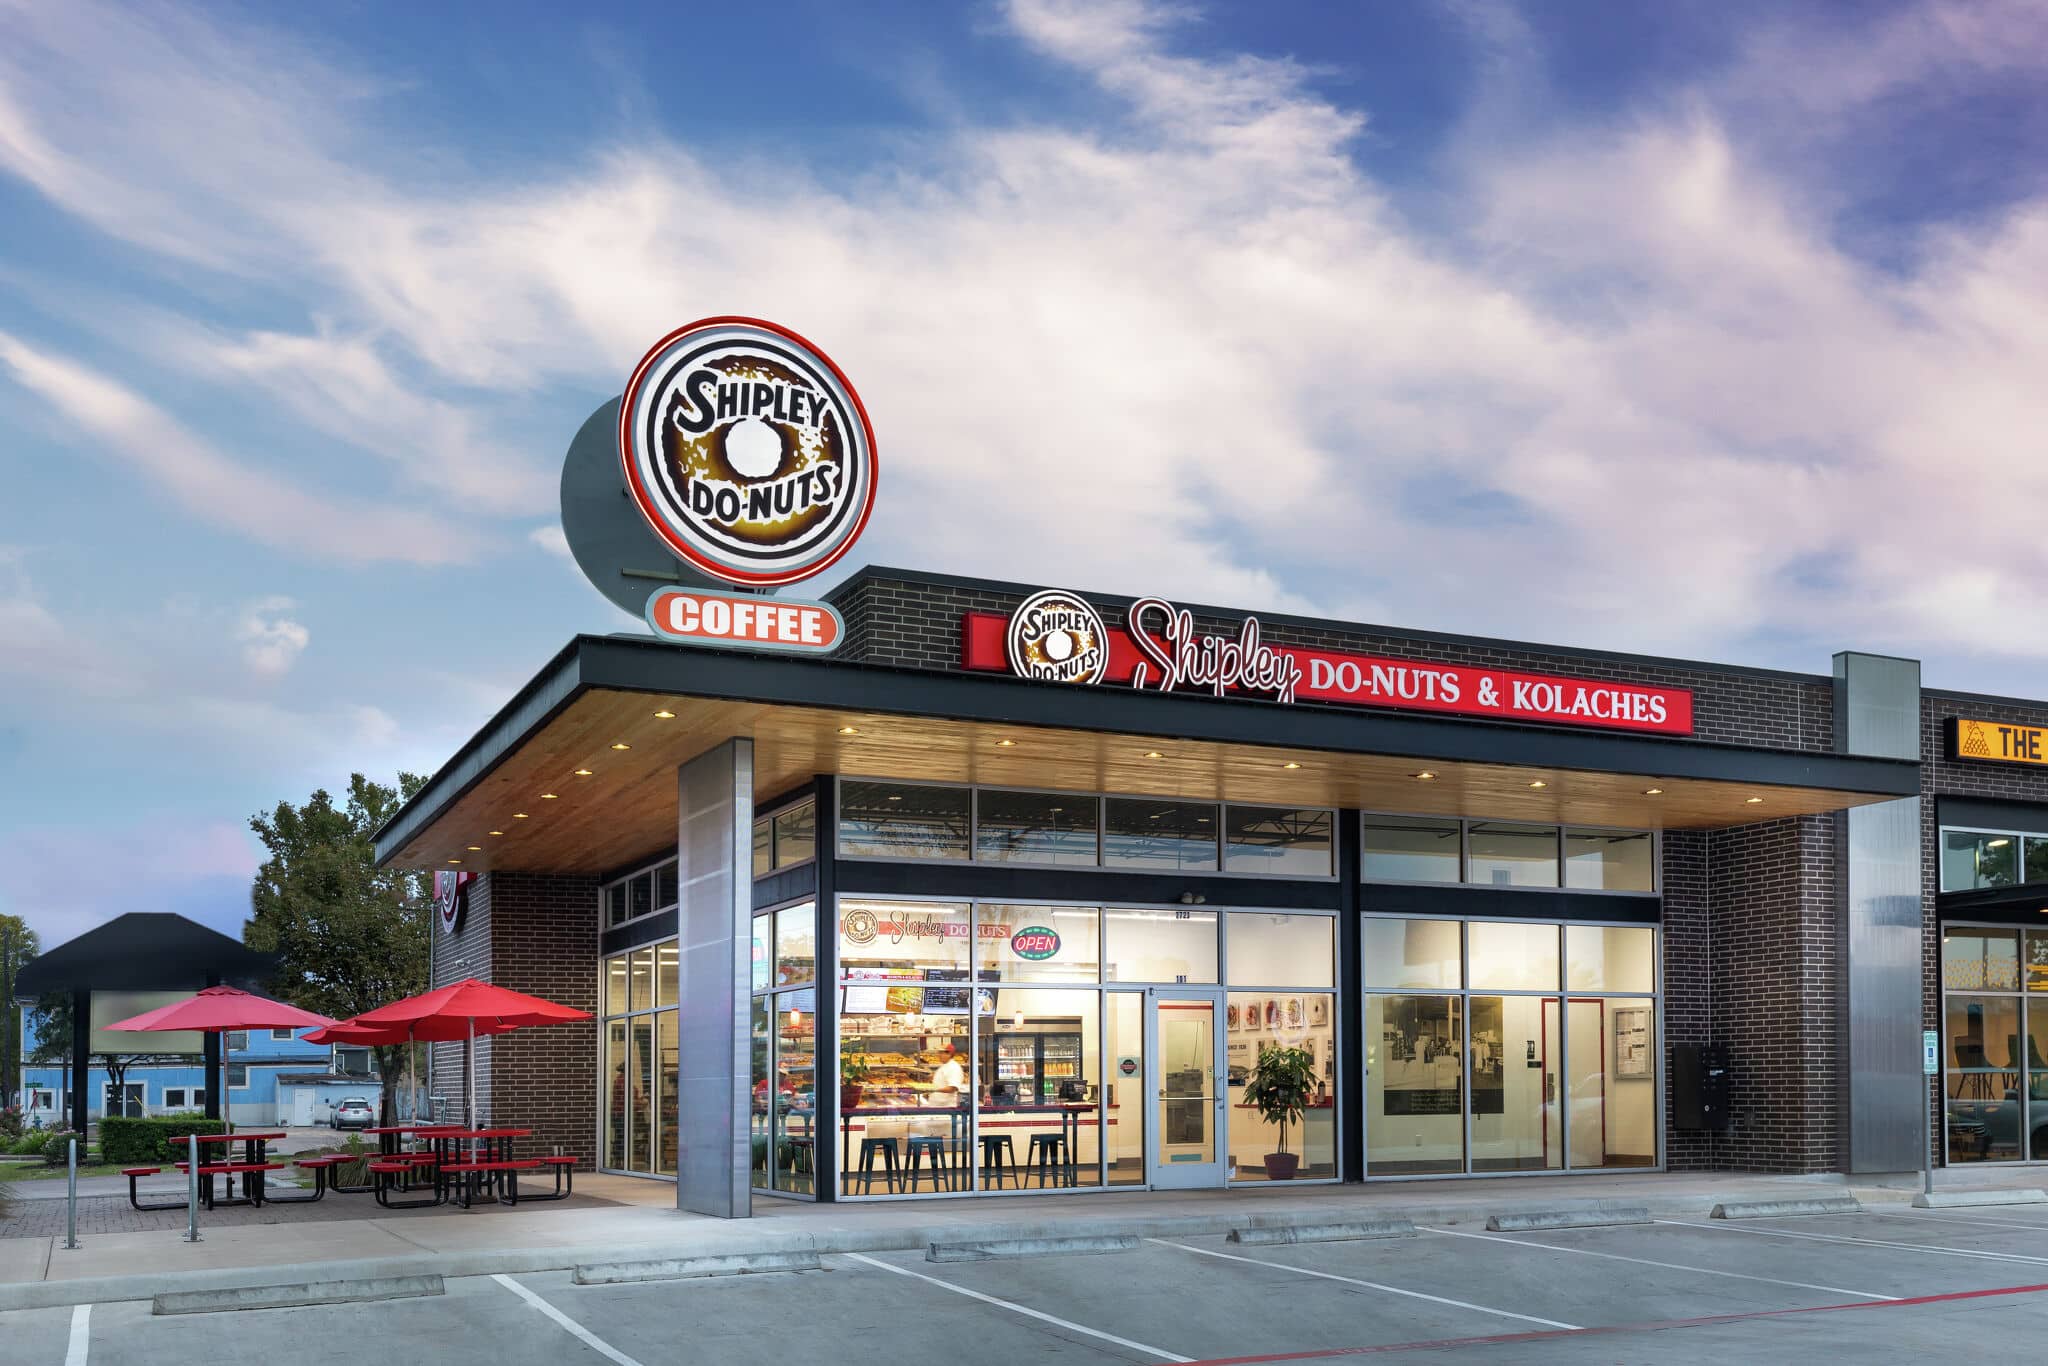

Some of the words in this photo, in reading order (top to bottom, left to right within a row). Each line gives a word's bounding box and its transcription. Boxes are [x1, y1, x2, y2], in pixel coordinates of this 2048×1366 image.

[677, 369, 828, 433] SHIPLEY
[692, 465, 833, 521] DO-NUTS
[669, 596, 822, 644] COFFEE
[1023, 608, 1092, 641] SHIPLEY
[1032, 649, 1096, 681] DO-NUTS
[1129, 597, 1302, 704] Shipley
[1310, 658, 1461, 703] DO-NUTS
[1477, 676, 1499, 707] &
[1512, 680, 1668, 724] KOLACHES
[1998, 726, 2042, 760] THE
[890, 911, 945, 945] Shipley
[1015, 936, 1057, 951] OPEN
